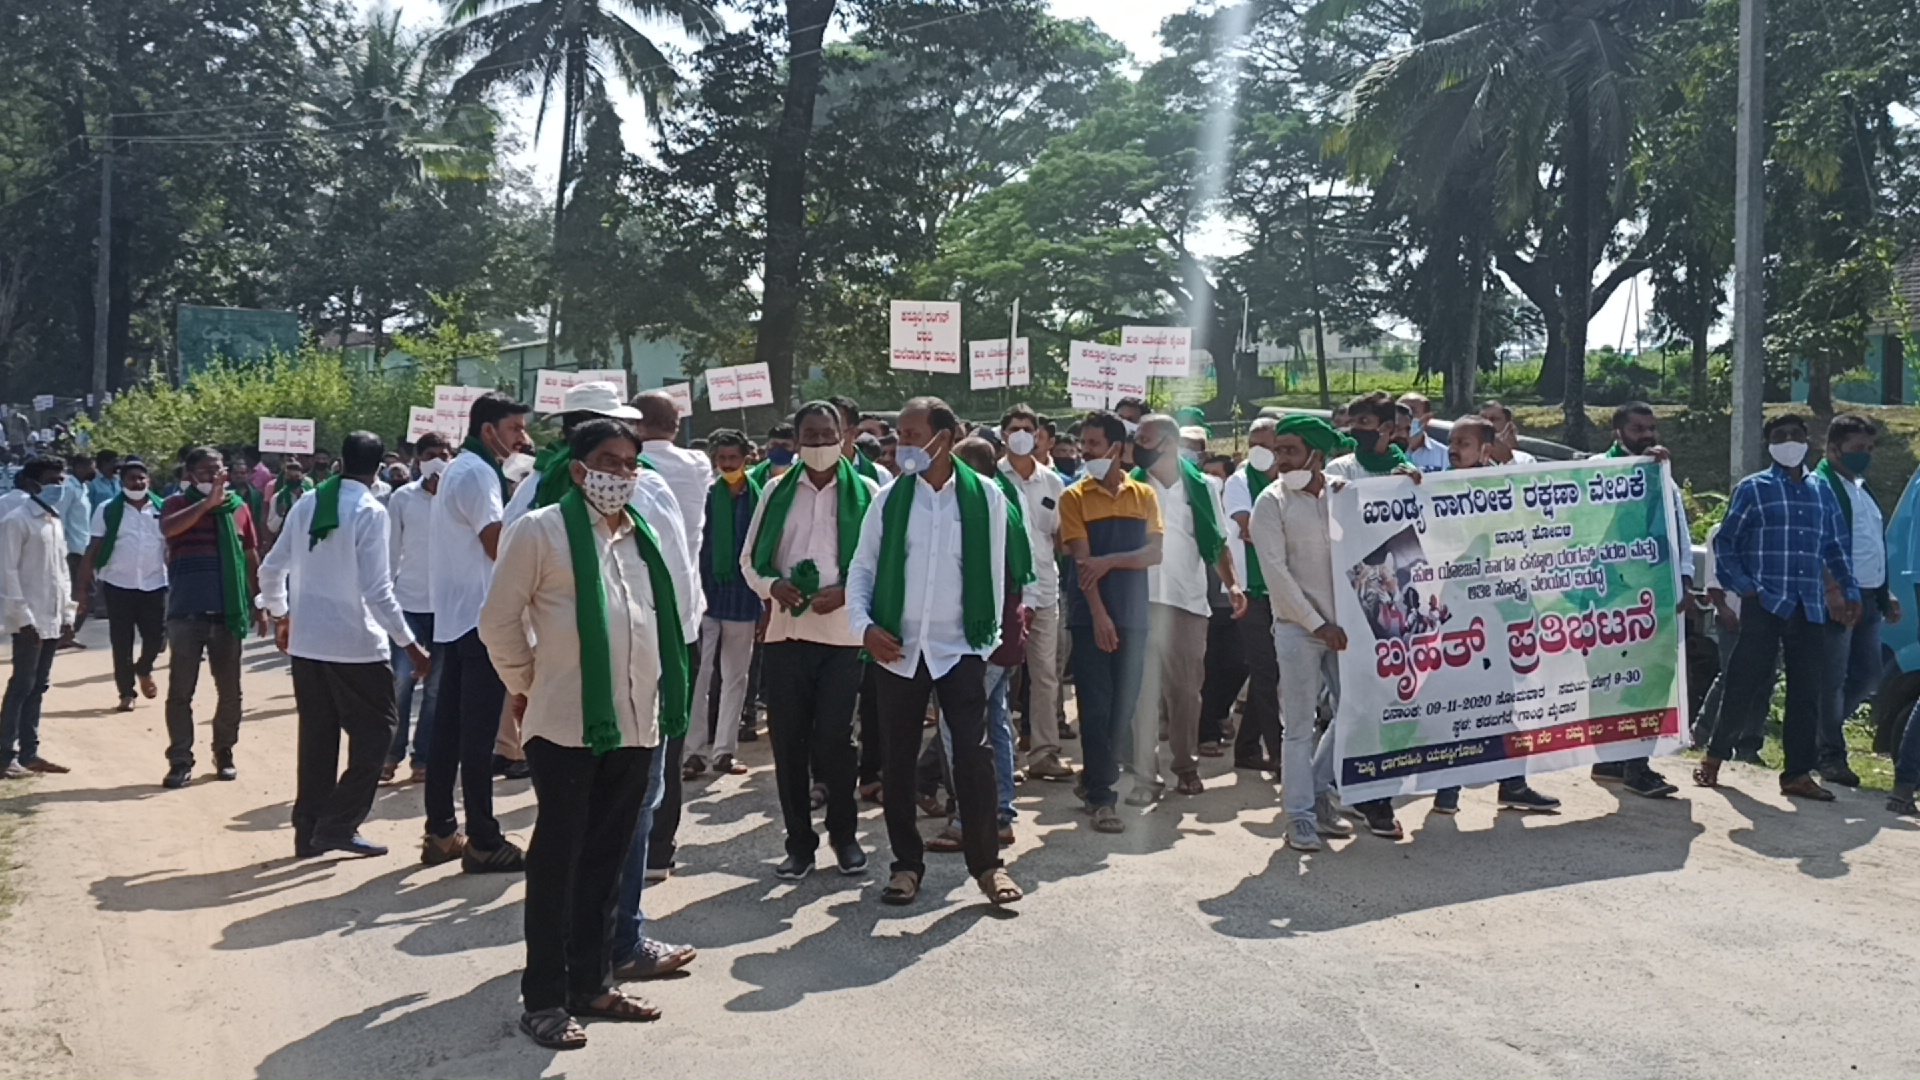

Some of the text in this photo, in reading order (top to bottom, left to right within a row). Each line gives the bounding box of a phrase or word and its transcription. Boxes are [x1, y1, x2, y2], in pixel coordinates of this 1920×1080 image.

[1363, 469, 1646, 534] ಖಾಂಡ್ಯ ನಾಗರೀಕ ರಕ್ಷಣಾ ವೇದಿಕೆ
[1438, 556, 1481, 580] ಯೋಜನೆ
[1485, 555, 1516, 575] ಹಾಗೂ
[1557, 545, 1596, 566] ರಂಗನ್
[1600, 542, 1627, 560] ವರದಿ
[1630, 539, 1658, 561] ಮತ್ತು
[1532, 524, 1572, 541] ಹೋಬಳಿ
[1375, 590, 1656, 701] ಬೃಹತ್ ಪ್ರತಿಭಟನೆ
[1382, 704, 1422, 722] ದಿನಾಂಕ:
[1426, 694, 1492, 716] 09-11-2020
[1496, 684, 1546, 706] ಸೋಮವಾರ
[1614, 668, 1641, 684] 9-30
